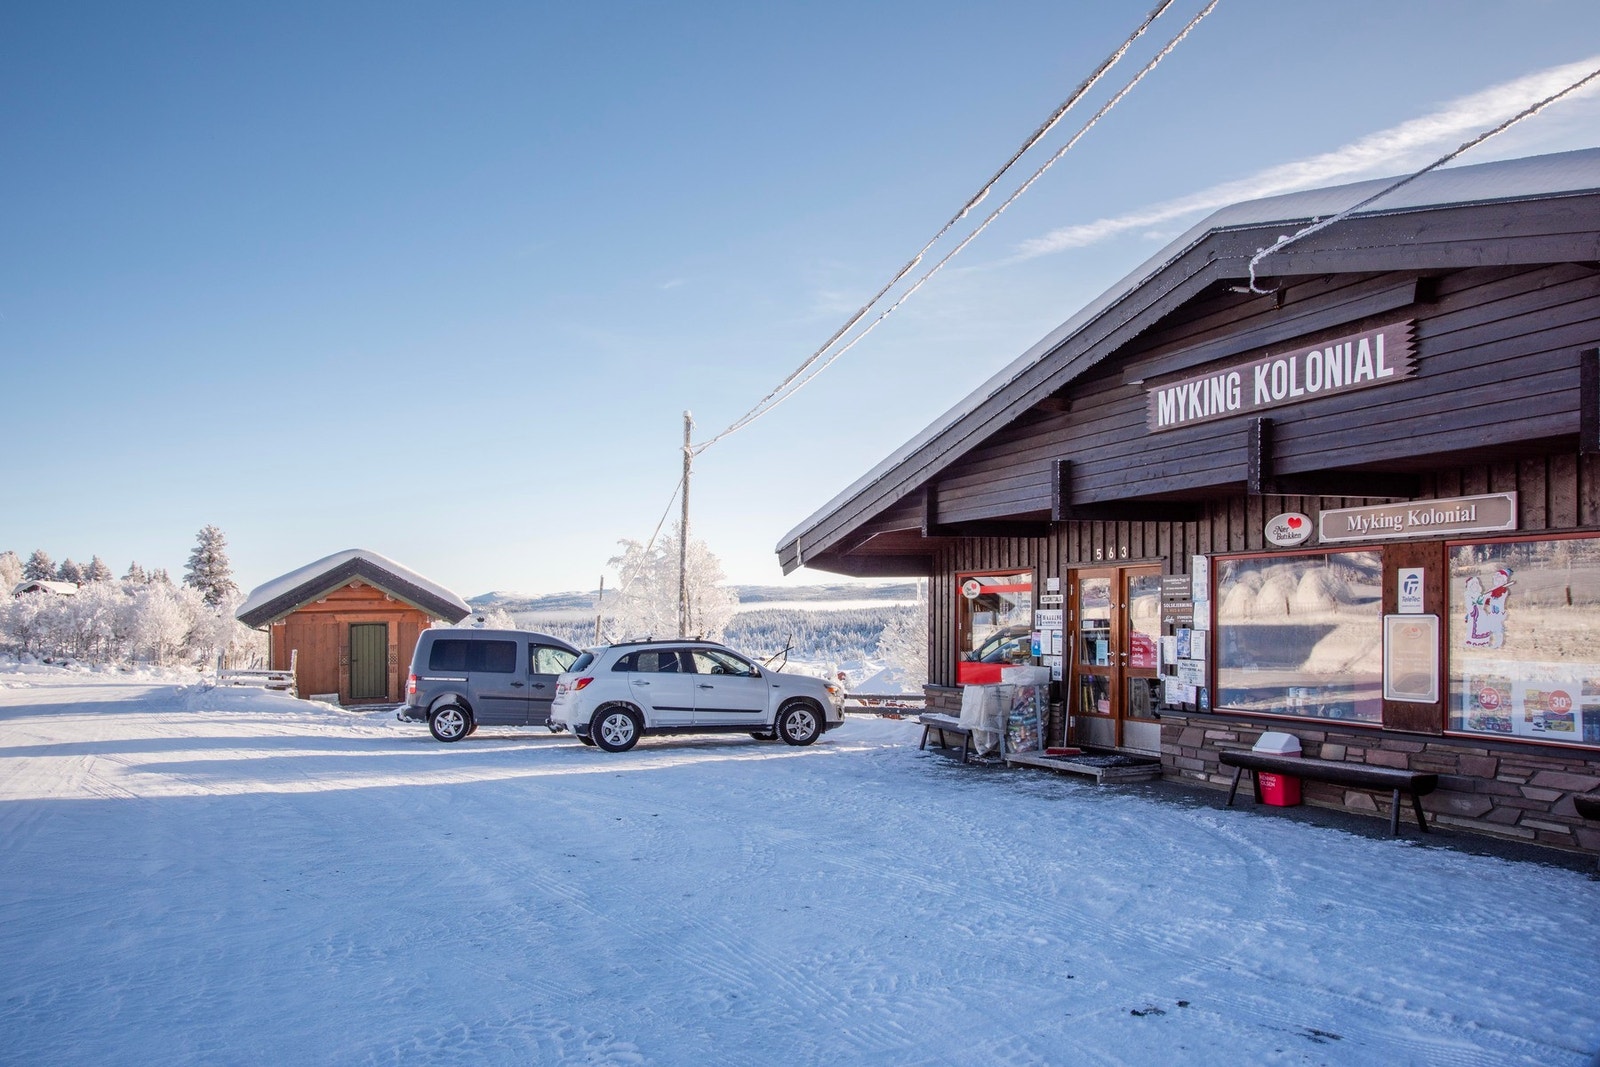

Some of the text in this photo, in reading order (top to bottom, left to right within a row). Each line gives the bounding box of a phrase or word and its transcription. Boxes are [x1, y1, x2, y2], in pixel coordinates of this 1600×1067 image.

[1158, 333, 1394, 426] MYKING KOLONIAL
[1347, 504, 1476, 534] Myking Kolonial
